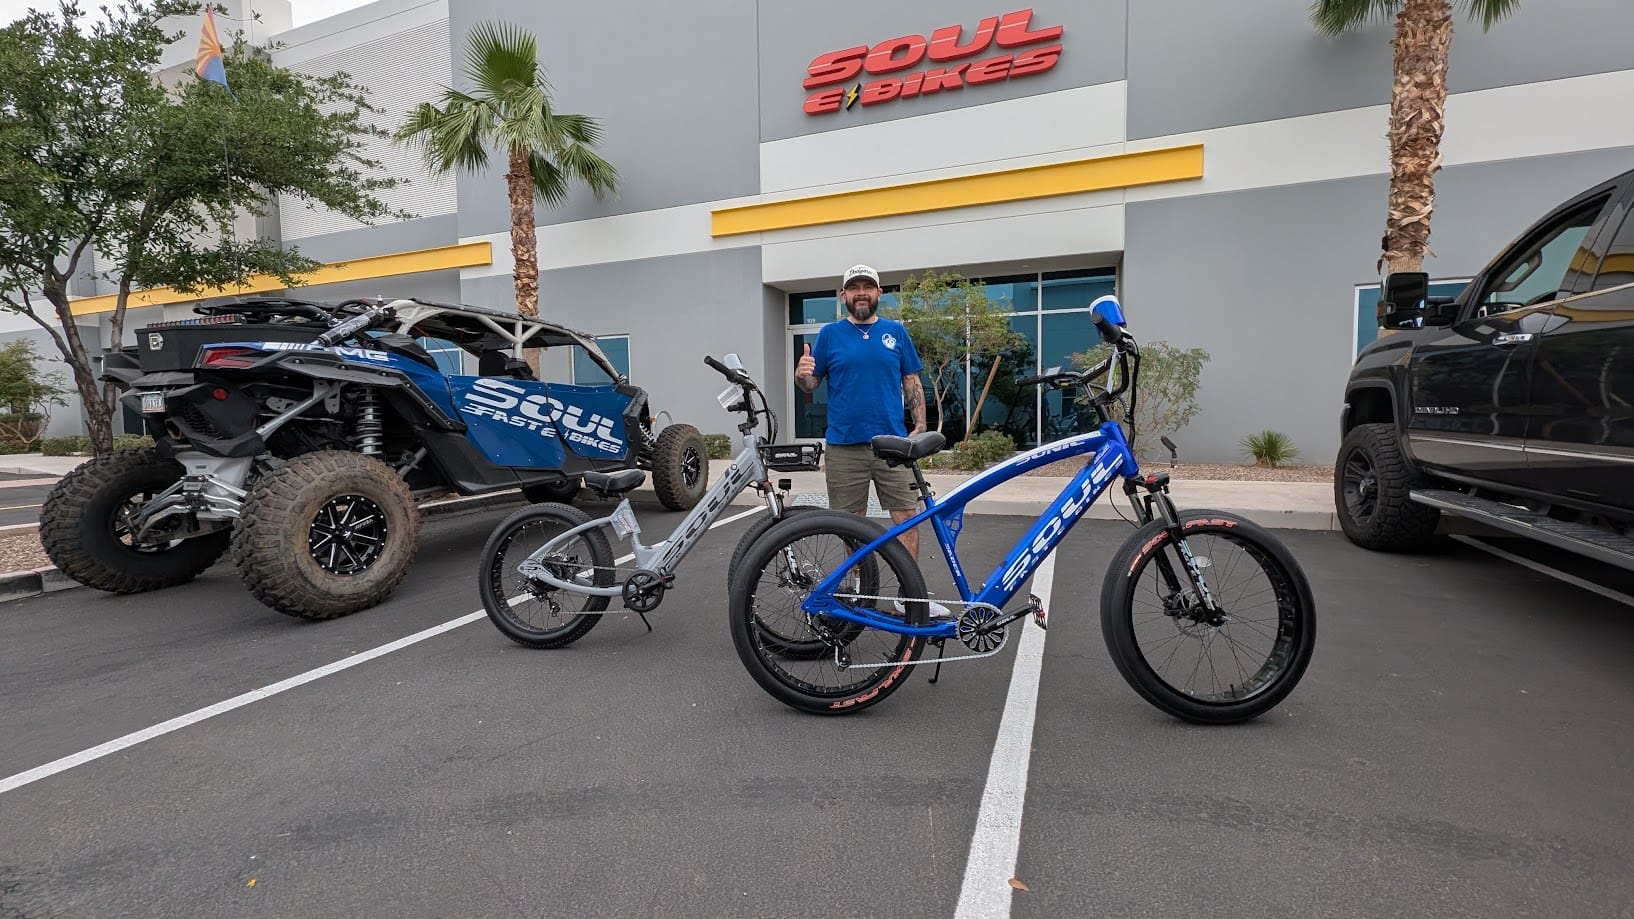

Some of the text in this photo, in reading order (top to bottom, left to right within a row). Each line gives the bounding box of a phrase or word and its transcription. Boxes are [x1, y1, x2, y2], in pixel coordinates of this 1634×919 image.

[803, 8, 1063, 89] SOUL
[803, 44, 1063, 116] E BIKES
[460, 403, 543, 431] FAST
[569, 433, 622, 454] BIKES
[465, 378, 623, 444] SOUL
[662, 461, 753, 565] SOUL
[1002, 453, 1122, 591] SOUL
